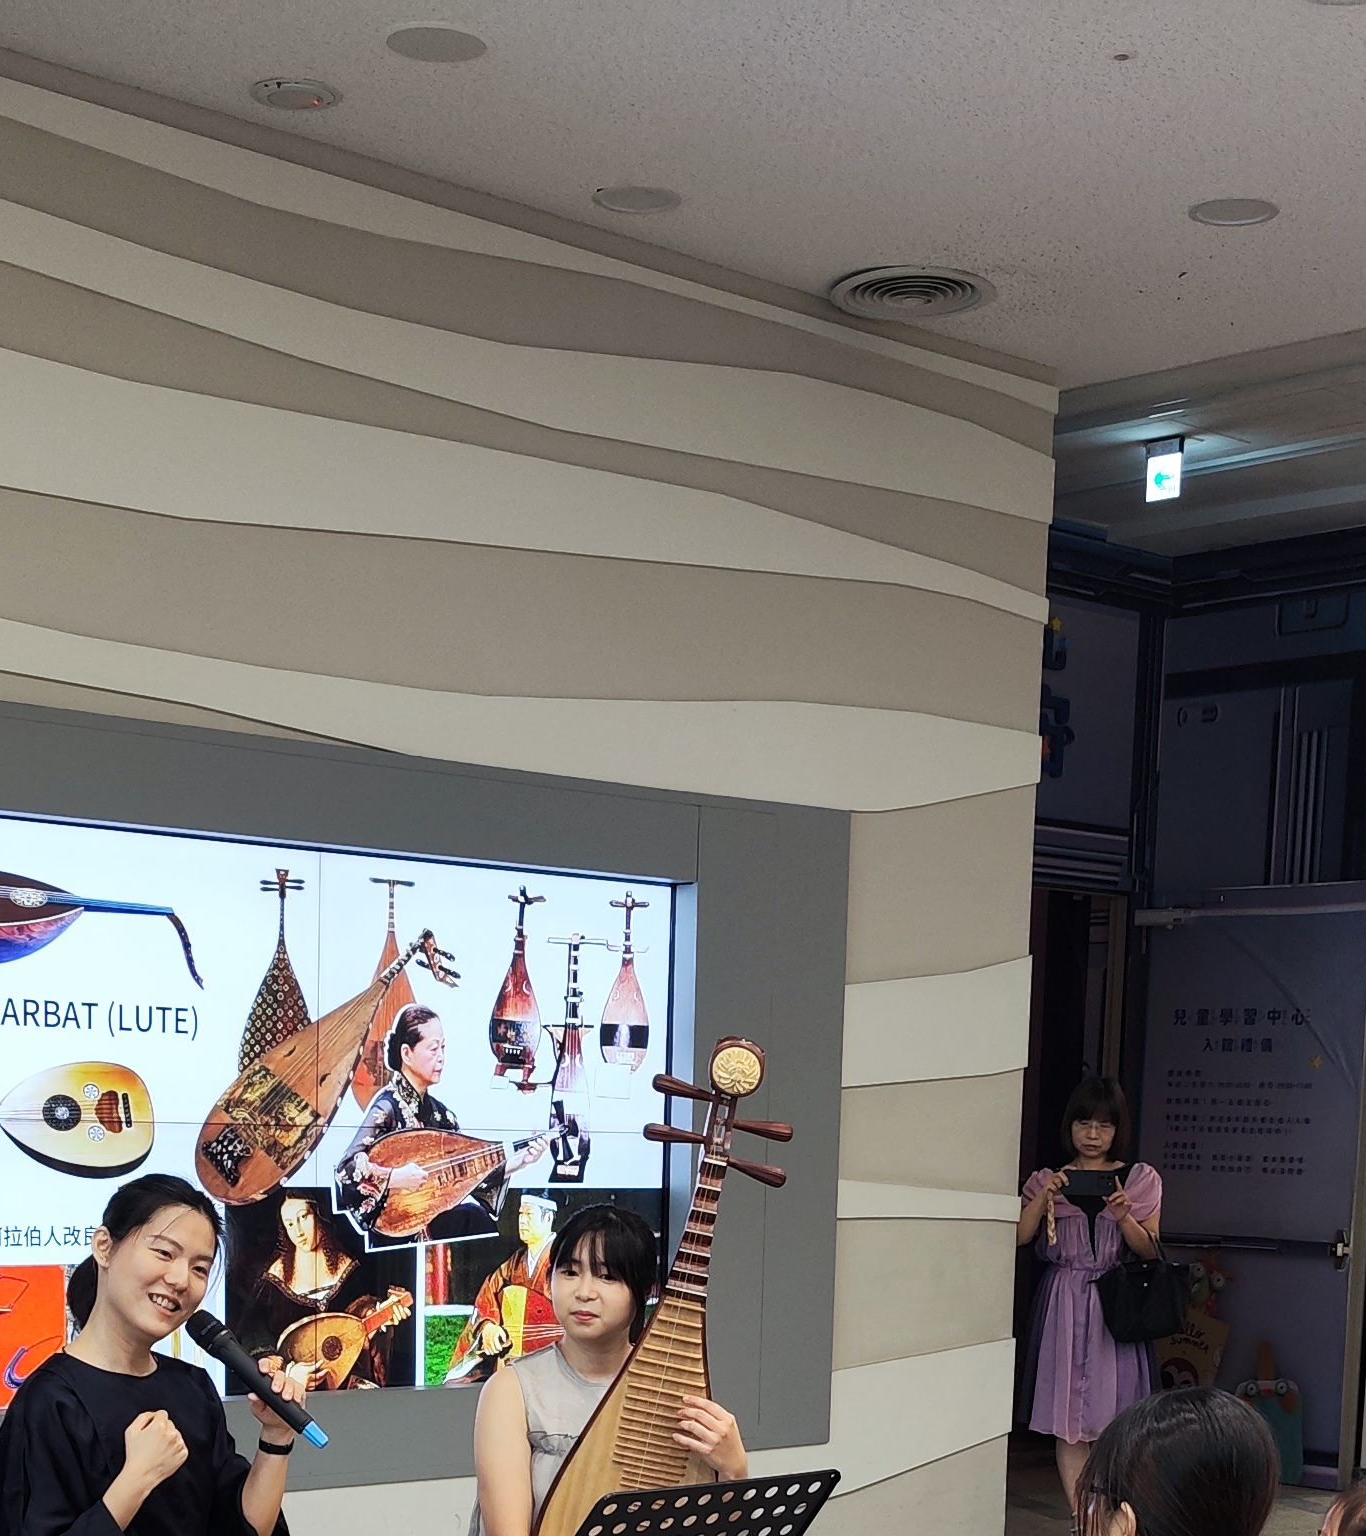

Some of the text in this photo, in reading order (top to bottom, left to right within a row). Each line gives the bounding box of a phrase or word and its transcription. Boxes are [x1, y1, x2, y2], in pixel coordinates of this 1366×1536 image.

[108, 1000, 198, 1041] (LUTE)
[1173, 1007, 1308, 1026] 兒童學習中心
